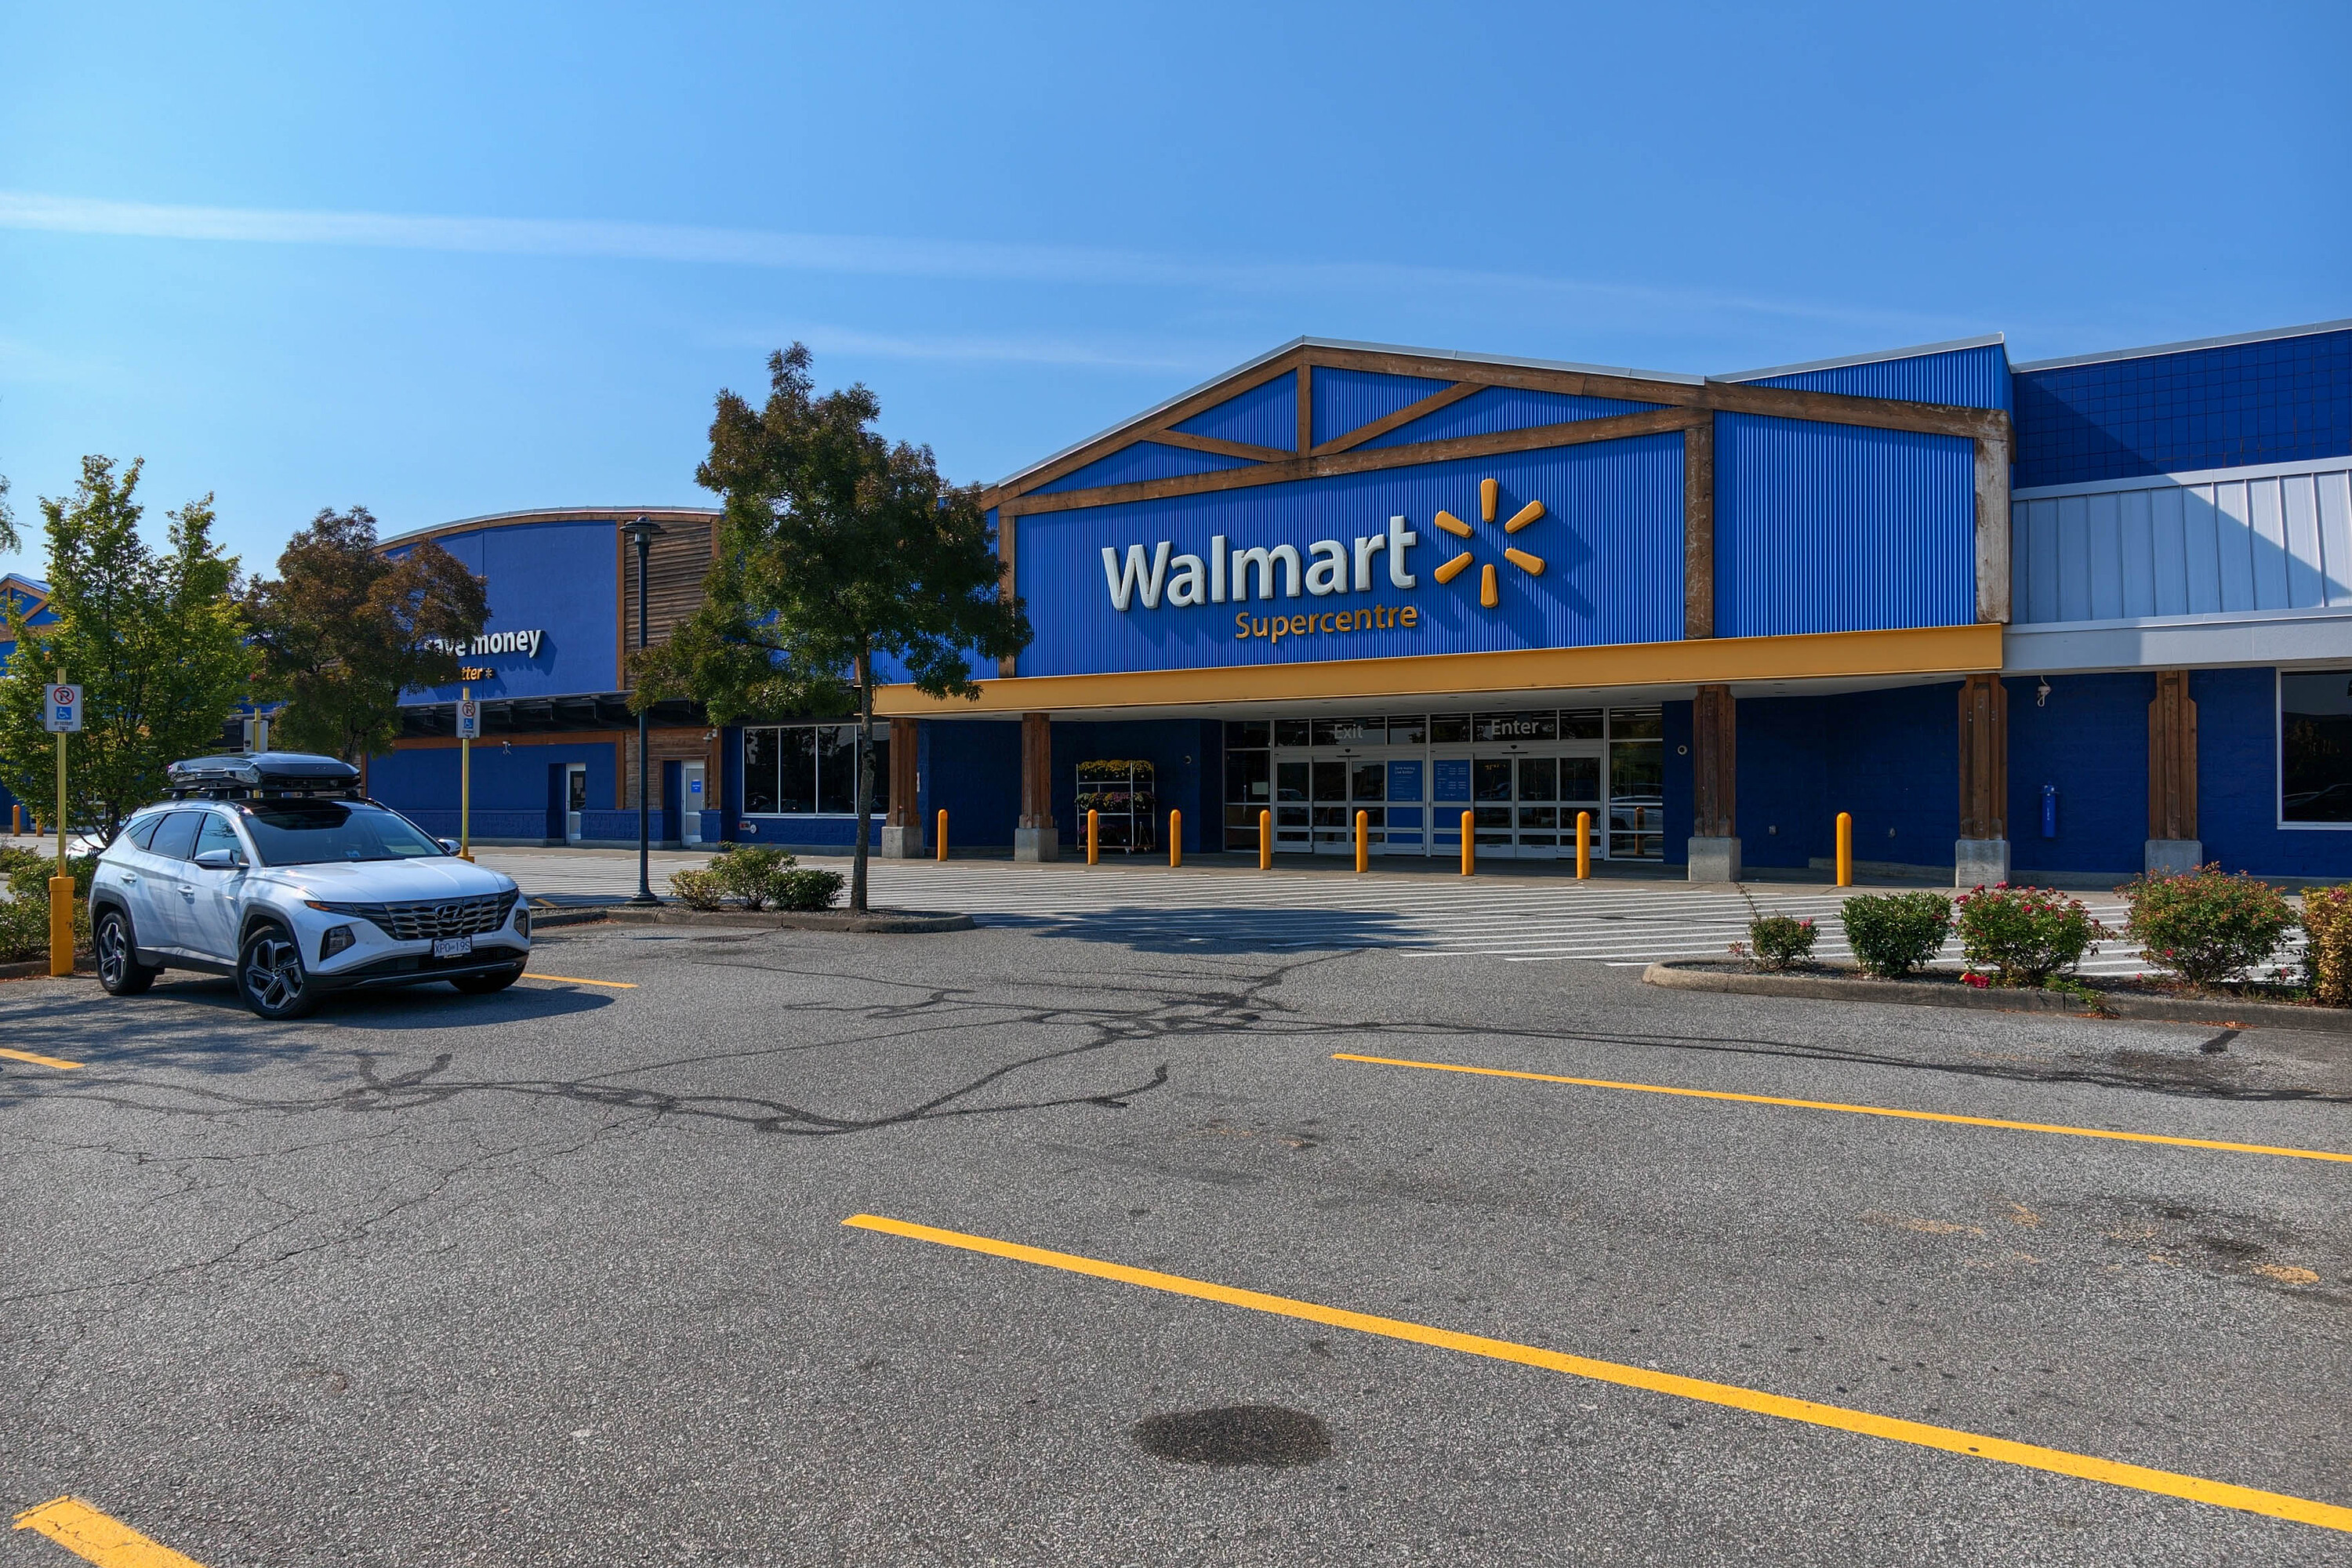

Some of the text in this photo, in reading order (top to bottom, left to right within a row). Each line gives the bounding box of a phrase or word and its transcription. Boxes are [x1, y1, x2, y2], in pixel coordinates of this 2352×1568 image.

[1102, 515, 1417, 612] Walmart
[1236, 604, 1417, 643] Supercentre
[471, 630, 542, 658] money
[460, 666, 483, 681] tter
[1334, 724, 1363, 739] Exit
[1490, 720, 1539, 736] Enter
